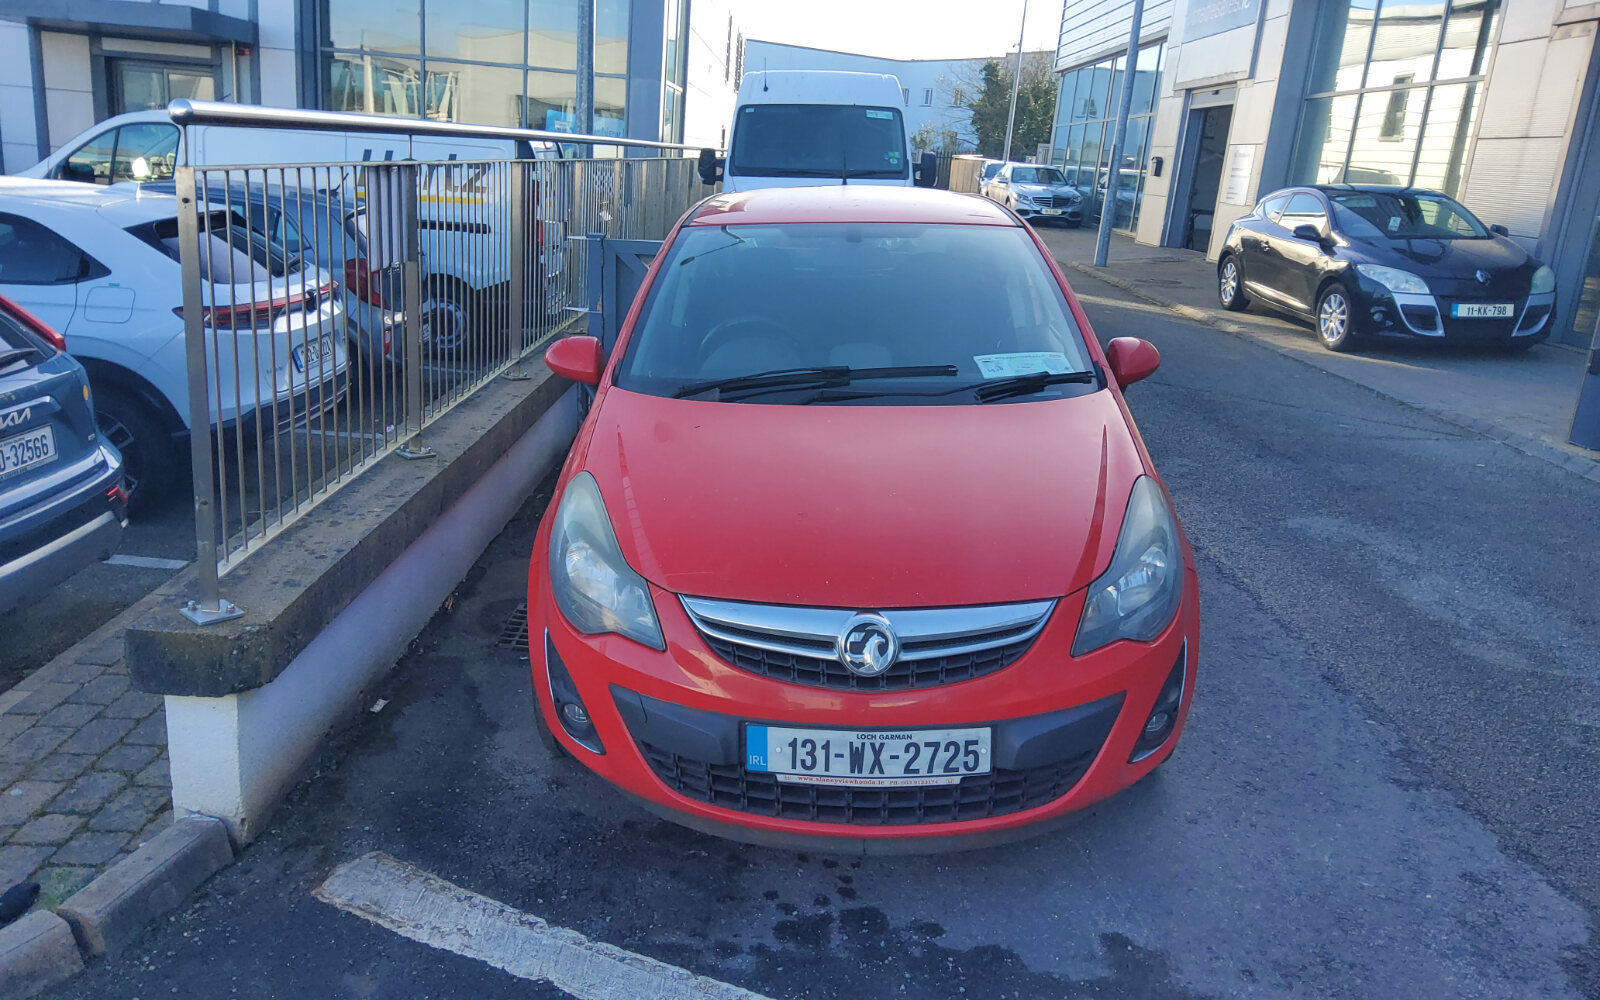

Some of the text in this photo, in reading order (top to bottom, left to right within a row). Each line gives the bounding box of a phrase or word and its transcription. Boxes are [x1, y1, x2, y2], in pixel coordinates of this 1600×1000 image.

[1467, 306, 1507, 316] 11-KK-798
[749, 755, 767, 766] IRL
[788, 737, 980, 774] 131-WX-2725
